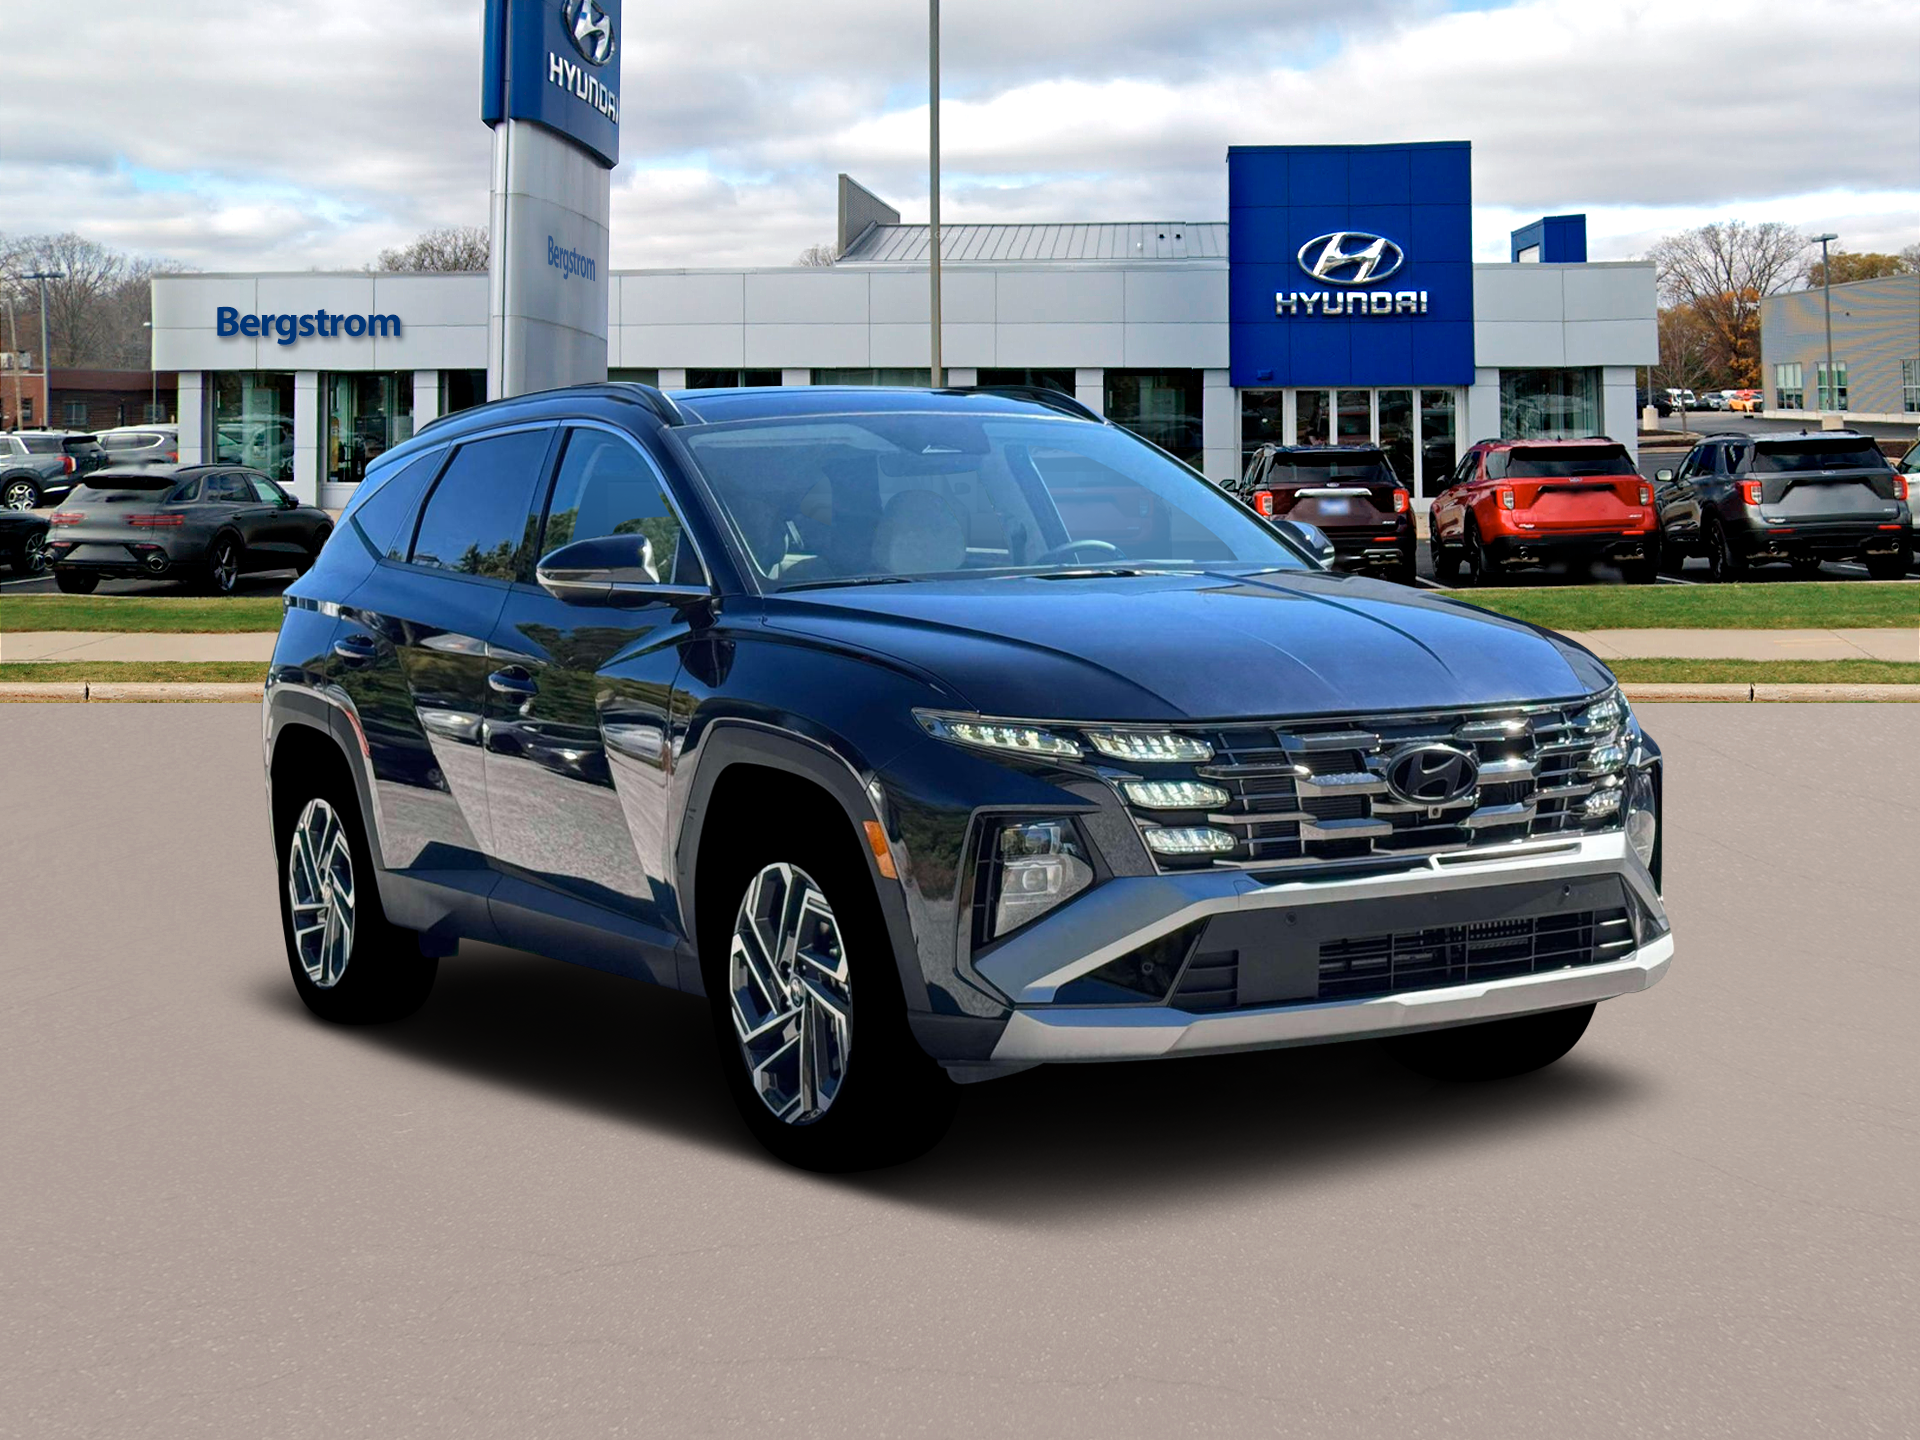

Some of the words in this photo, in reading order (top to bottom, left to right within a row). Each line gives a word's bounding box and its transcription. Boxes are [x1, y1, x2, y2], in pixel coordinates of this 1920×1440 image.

[548, 52, 619, 124] HYUNDAI
[547, 235, 596, 281] Bergstrom
[1275, 291, 1429, 316] HYUNDAI
[216, 306, 400, 345] Bergstrom
